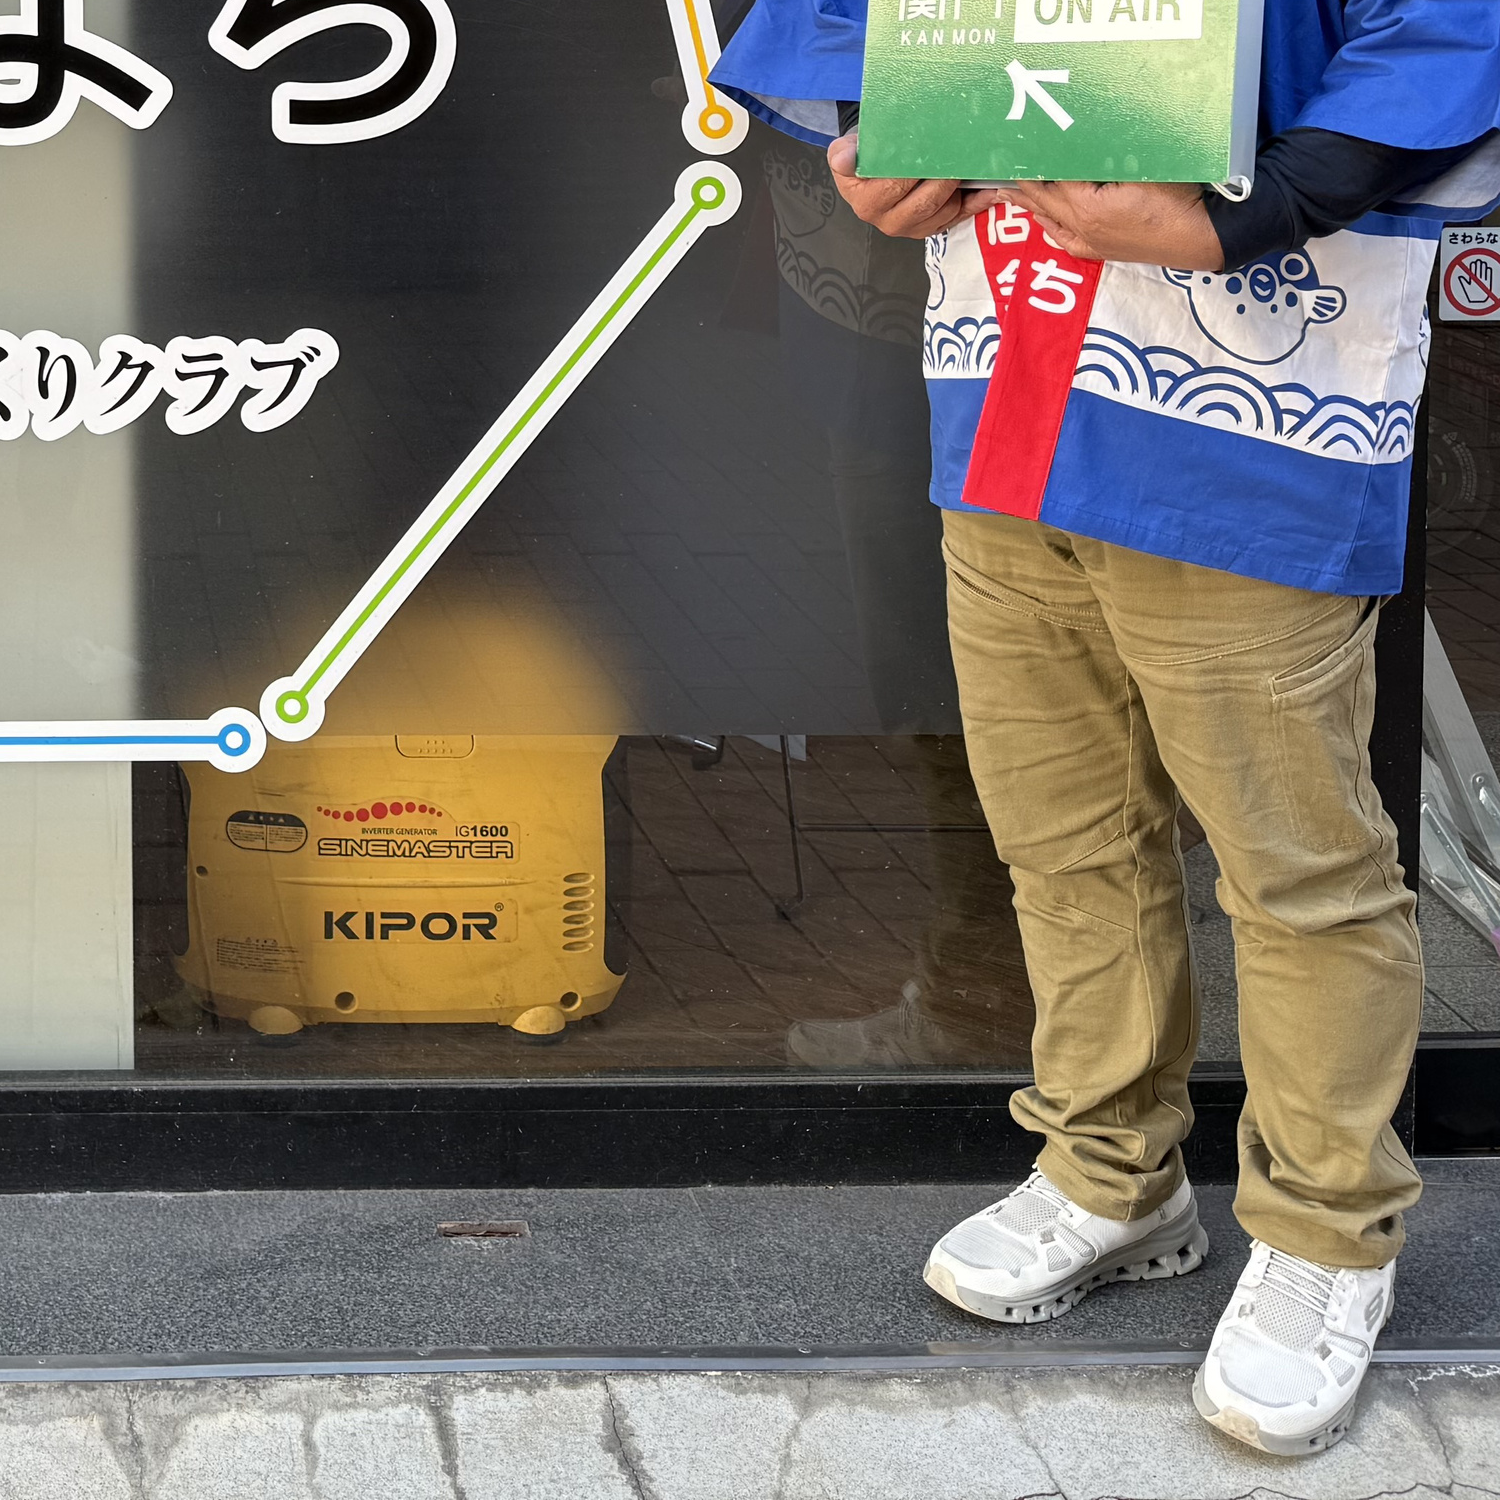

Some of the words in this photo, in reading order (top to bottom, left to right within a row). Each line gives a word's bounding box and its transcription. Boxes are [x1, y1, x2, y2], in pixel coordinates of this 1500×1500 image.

[1448, 232, 1500, 245] さわらな
[361, 827, 394, 835] INVERTER
[395, 827, 438, 836] GENERATOR
[455, 825, 509, 838] IG1600
[318, 838, 514, 859] SINEMASTER
[324, 910, 498, 940] KIPOR
